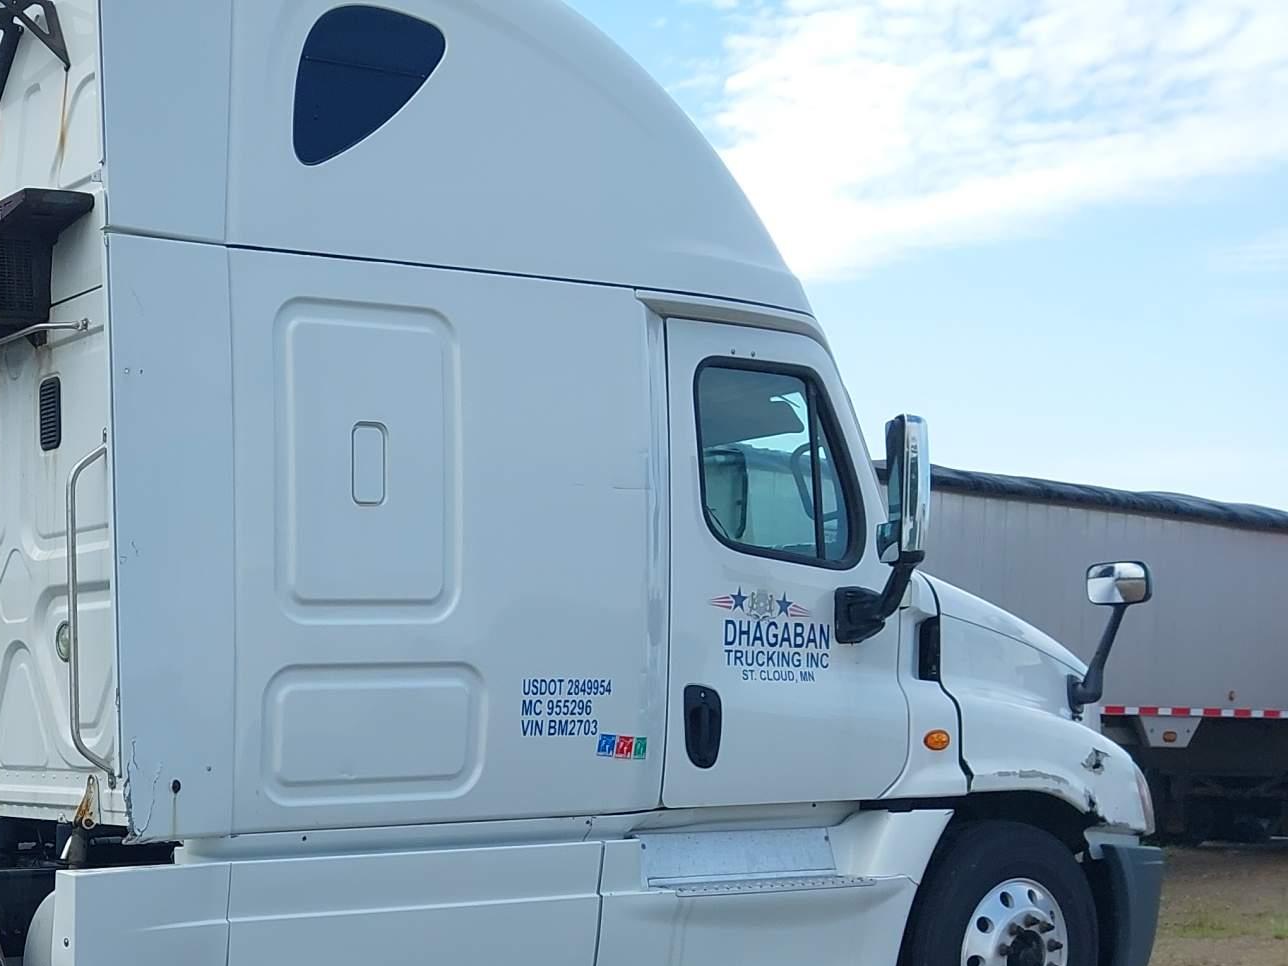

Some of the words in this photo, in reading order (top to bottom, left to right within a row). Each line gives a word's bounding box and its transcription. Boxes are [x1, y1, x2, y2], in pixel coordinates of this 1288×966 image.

[724, 619, 830, 649] DHAGABAN
[724, 649, 801, 668] TRUCKING
[806, 652, 830, 668] INC
[800, 671, 815, 682] MN
[522, 679, 564, 696] USDOT
[567, 679, 612, 696] 2849954
[521, 699, 543, 716] MC
[546, 699, 592, 716] 955296
[521, 719, 544, 736] VIN
[547, 719, 598, 736] BM2703
